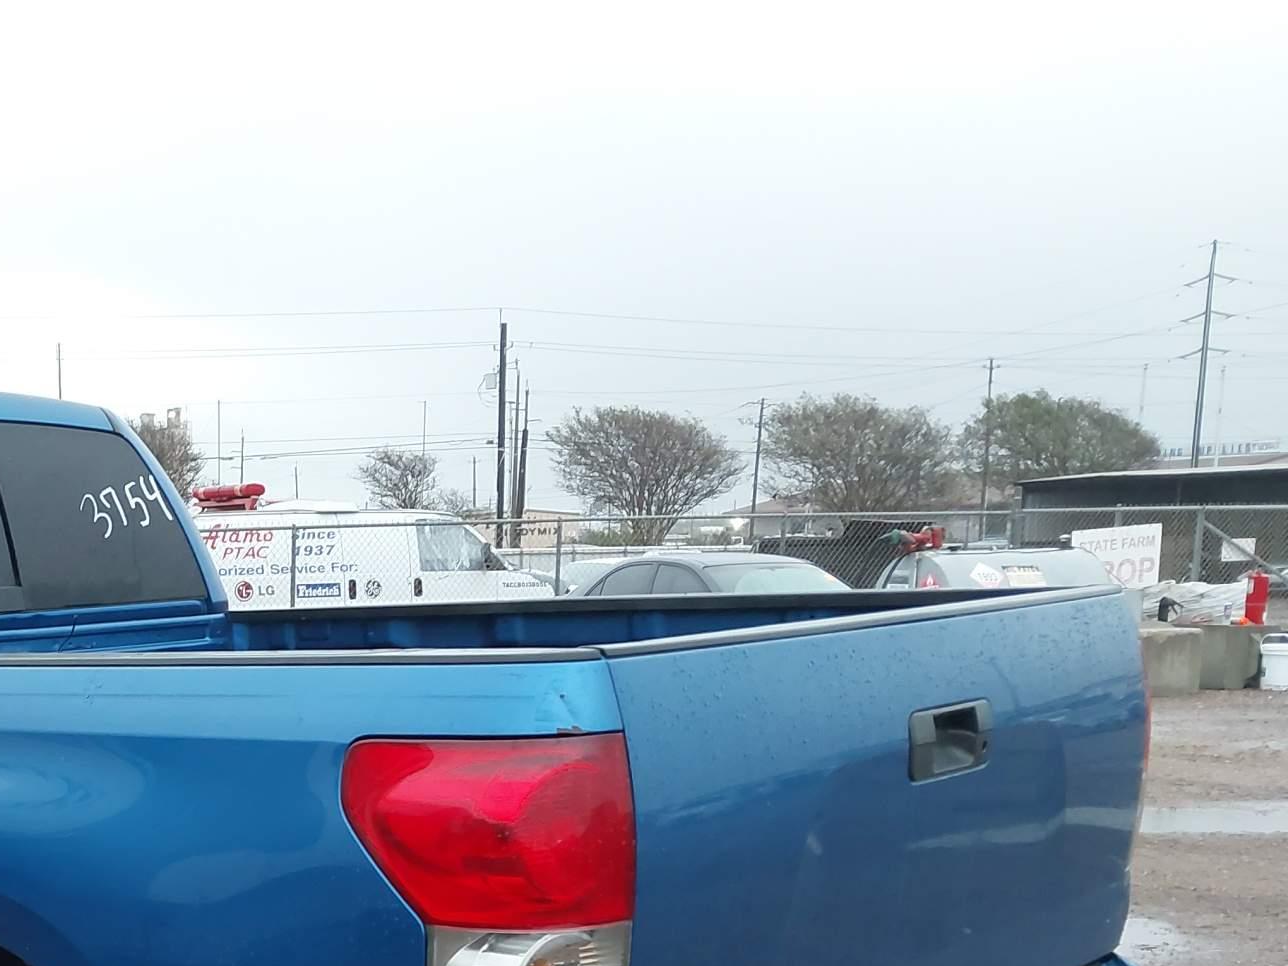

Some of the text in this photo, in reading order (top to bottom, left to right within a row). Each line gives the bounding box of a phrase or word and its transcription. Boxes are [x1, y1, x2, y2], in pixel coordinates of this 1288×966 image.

[80, 474, 173, 538] 3754
[203, 524, 273, 549] Alamo
[292, 529, 336, 540] Since
[1120, 535, 1156, 549] FARM
[222, 546, 269, 560] PTAC
[294, 545, 335, 557] 1937
[218, 564, 264, 577] orized
[331, 561, 359, 573] For:
[258, 584, 275, 597] LG
[298, 584, 340, 597] Friedrich
